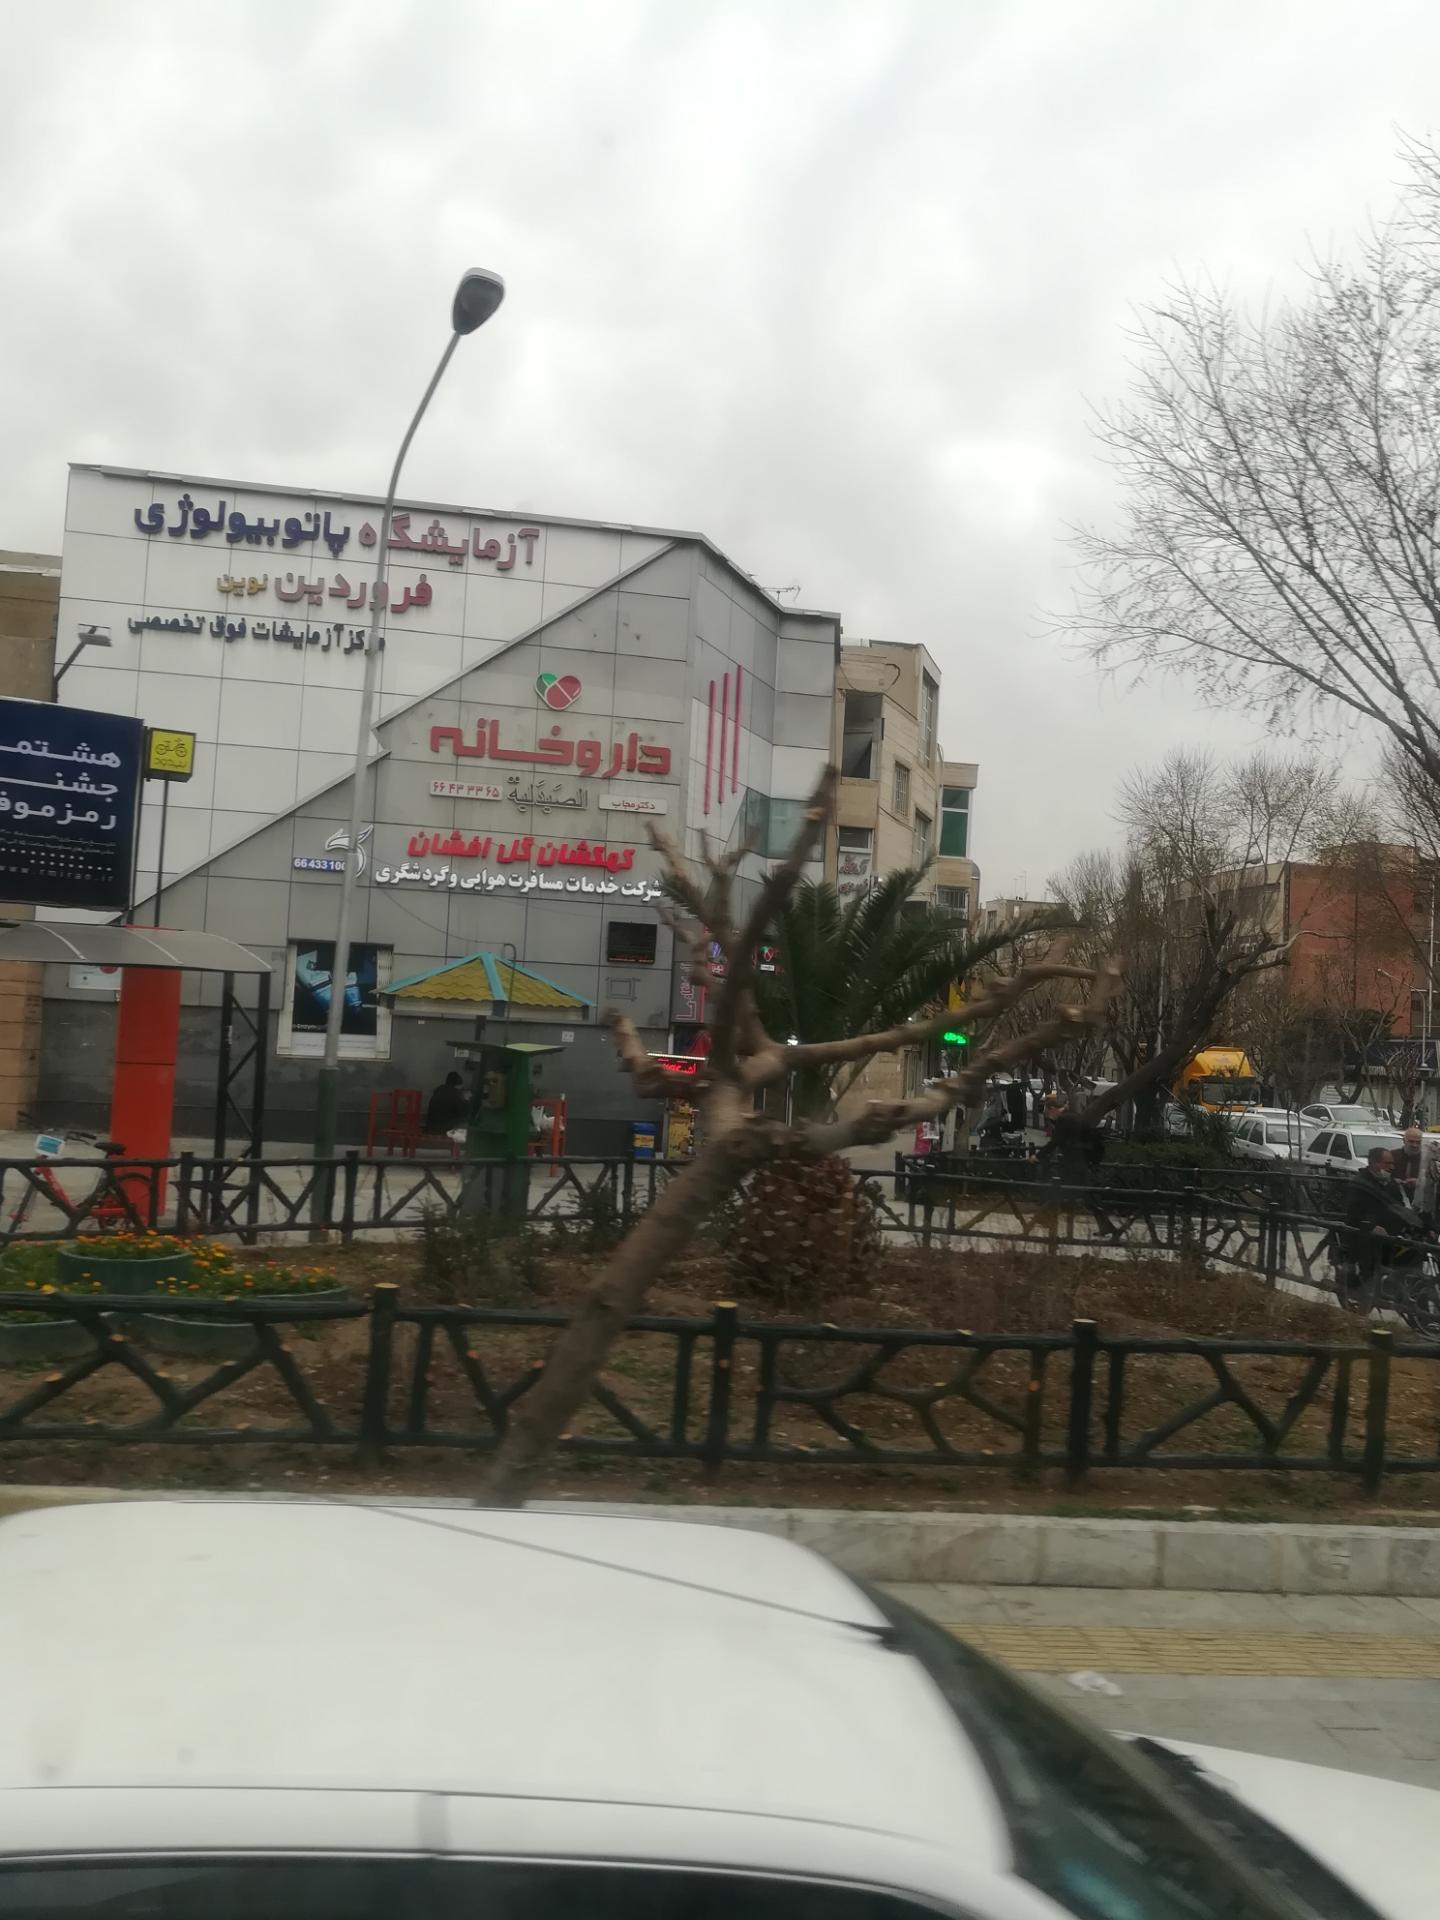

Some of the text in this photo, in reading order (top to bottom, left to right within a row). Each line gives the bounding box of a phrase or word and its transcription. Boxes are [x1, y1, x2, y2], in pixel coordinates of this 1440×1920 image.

[133, 494, 540, 570] آزمایشگه پاتوبیولوژی
[217, 572, 433, 613] فروردین نوین
[127, 613, 206, 635] تخصصی
[209, 616, 247, 641] فوق
[343, 628, 386, 655] مکز
[429, 718, 672, 778] داروخانه
[407, 830, 492, 859] افشان
[460, 868, 506, 890] هوایی
[507, 868, 563, 891] مسافرت
[565, 876, 619, 896] خدمات
[620, 879, 662, 902] شرکت
